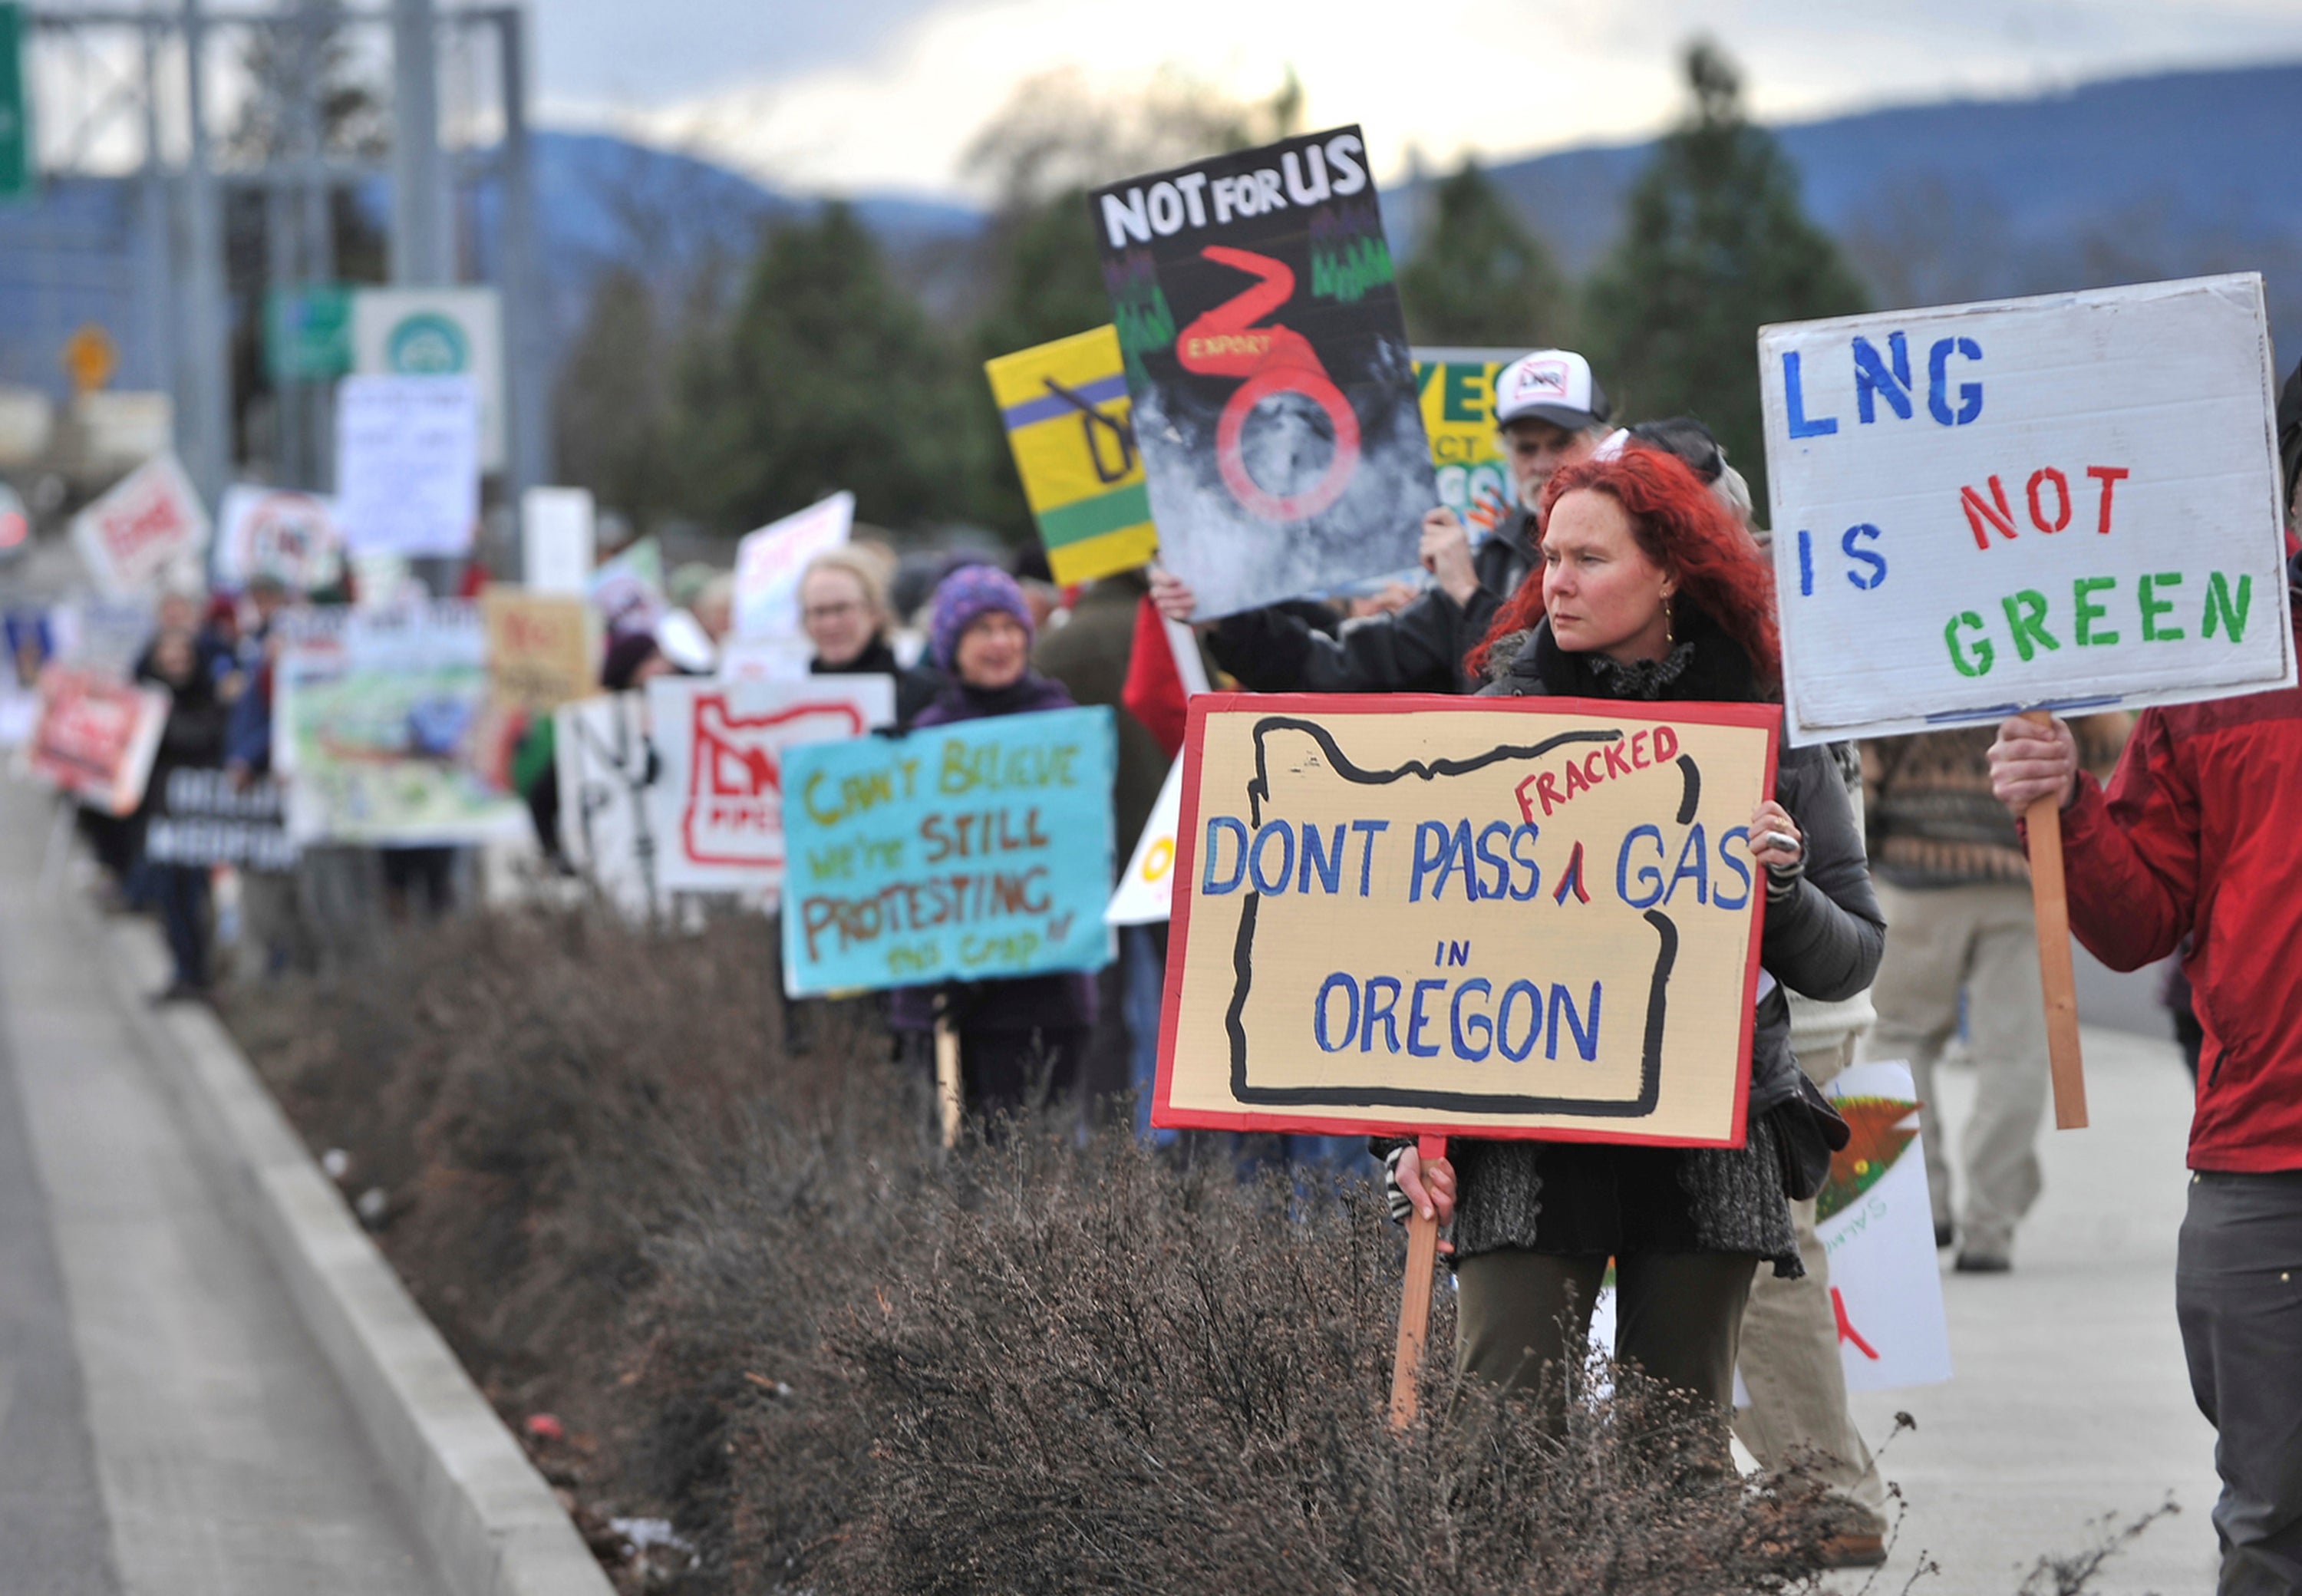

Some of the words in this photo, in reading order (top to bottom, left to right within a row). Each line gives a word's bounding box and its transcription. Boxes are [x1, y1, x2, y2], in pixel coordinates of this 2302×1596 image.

[1100, 171, 1207, 247] NOT
[1211, 168, 1288, 224] FOR
[1281, 134, 1367, 206] US
[1783, 331, 1983, 439] LNG
[1798, 523, 1887, 596] IS
[1960, 466, 2129, 549] NOT
[1944, 572, 2251, 677] GREEN
[714, 733, 780, 796] LN
[1514, 726, 1678, 825] FRACKED
[919, 807, 1049, 864] STILL
[1202, 816, 1389, 897] DONT
[1409, 818, 1539, 903] PASS
[1617, 823, 1751, 910] GAS
[802, 865, 1051, 962] PROTESTING
[1435, 940, 1469, 966] IN
[1314, 971, 1601, 1062] OREGON
